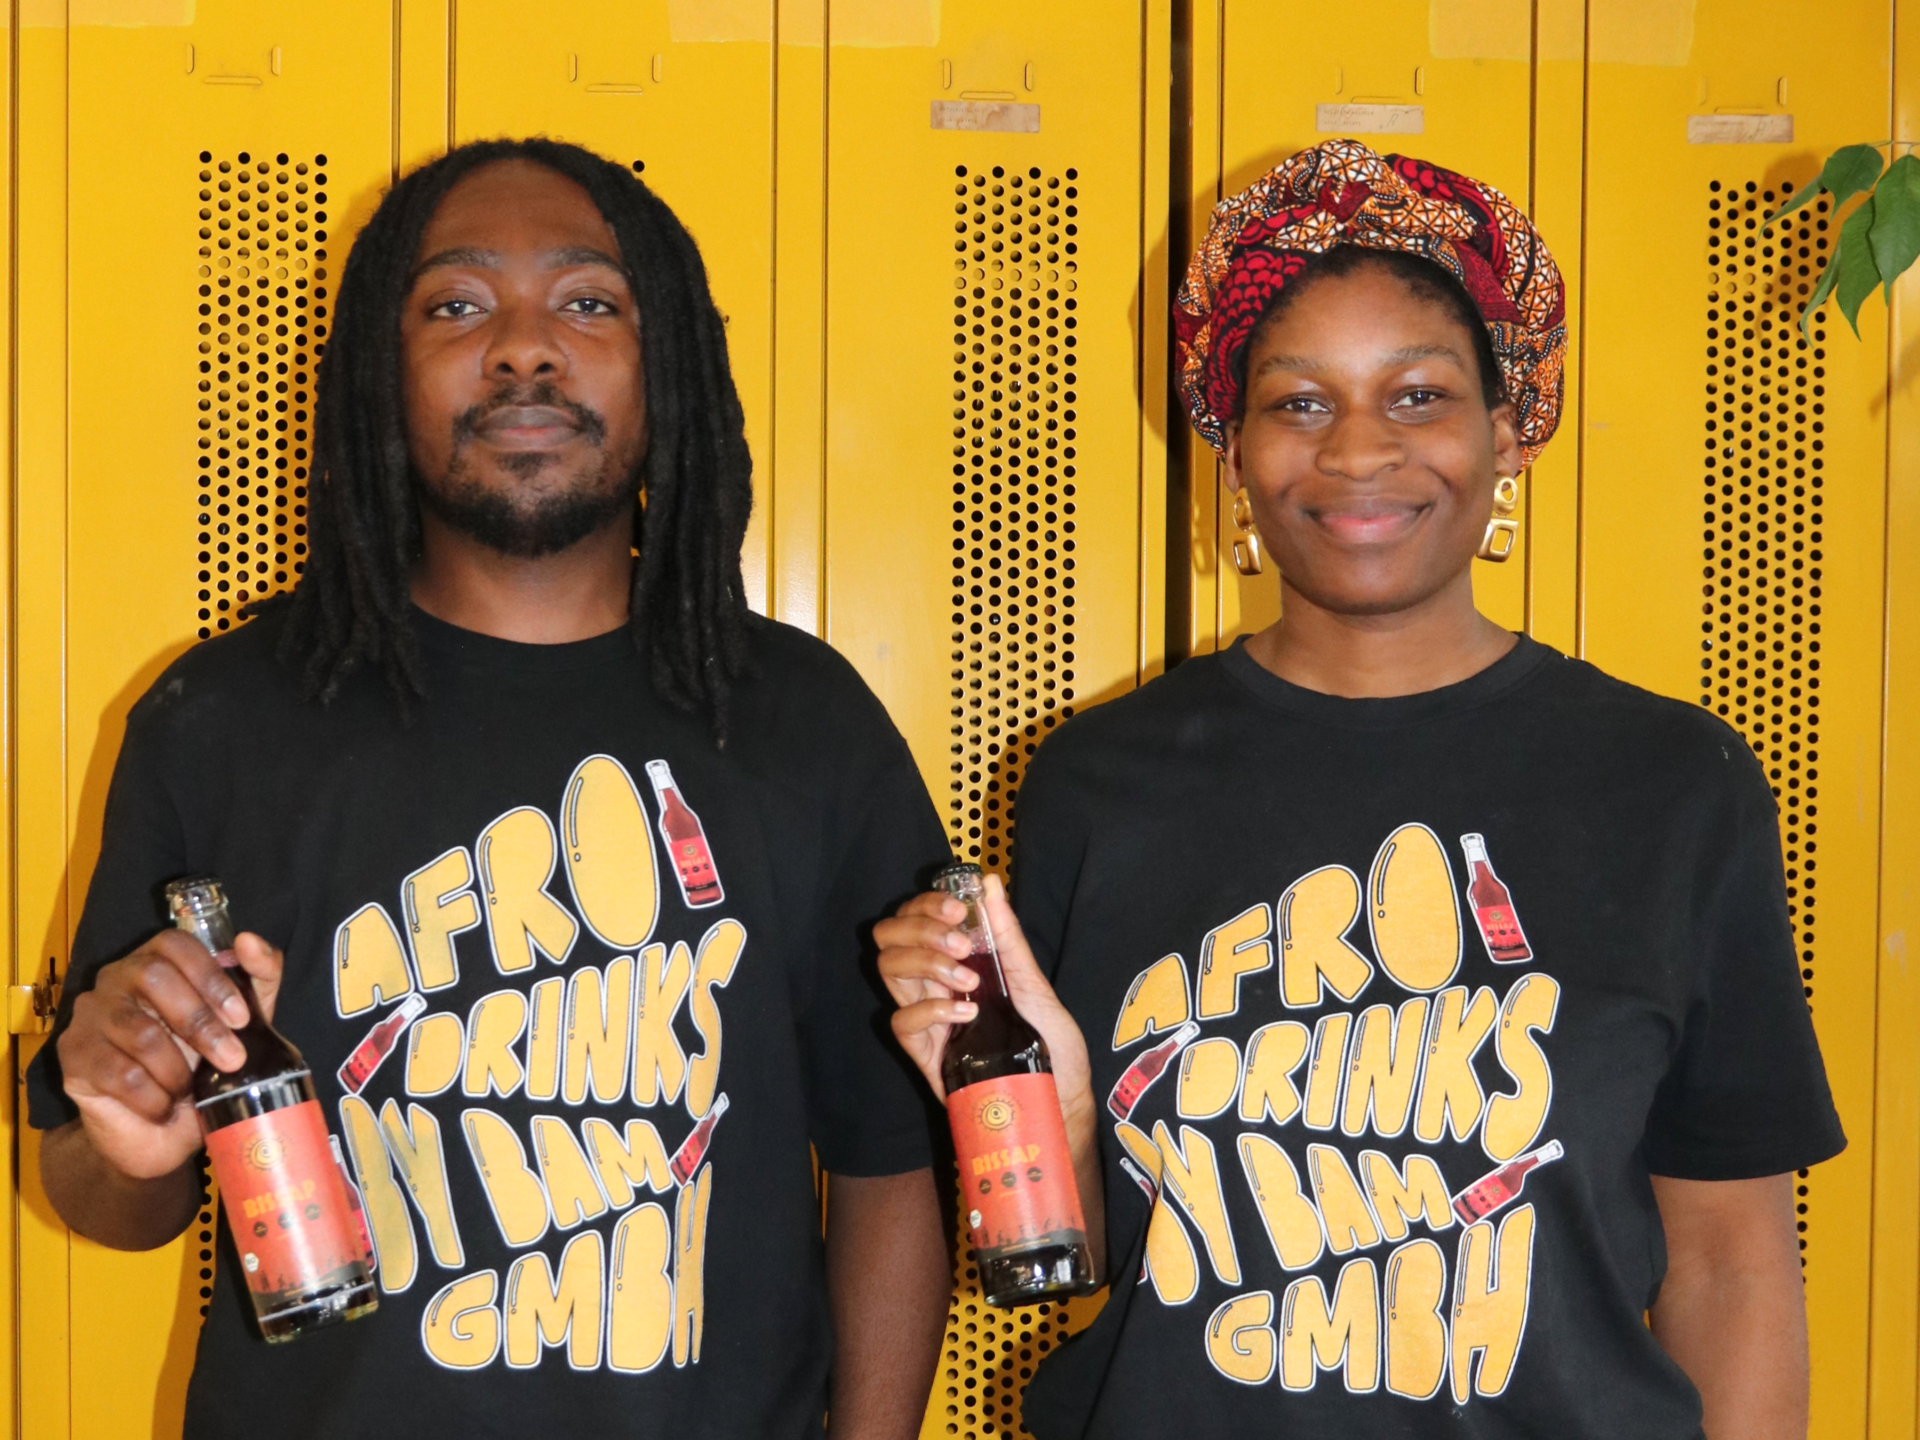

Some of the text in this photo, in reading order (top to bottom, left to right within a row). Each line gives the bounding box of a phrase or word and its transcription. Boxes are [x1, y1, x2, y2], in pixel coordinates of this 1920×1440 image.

[333, 753, 661, 1019] AFRO
[1112, 822, 1463, 1051] AFRO
[404, 918, 747, 1120] DRINKS
[1176, 971, 1560, 1163] DRINKS
[338, 1095, 674, 1294] BY BAM
[972, 1143, 1041, 1176] BISSAP
[1237, 1132, 1455, 1271] BAM
[421, 1162, 712, 1373] GMBH
[1205, 1202, 1536, 1405] GMBH
